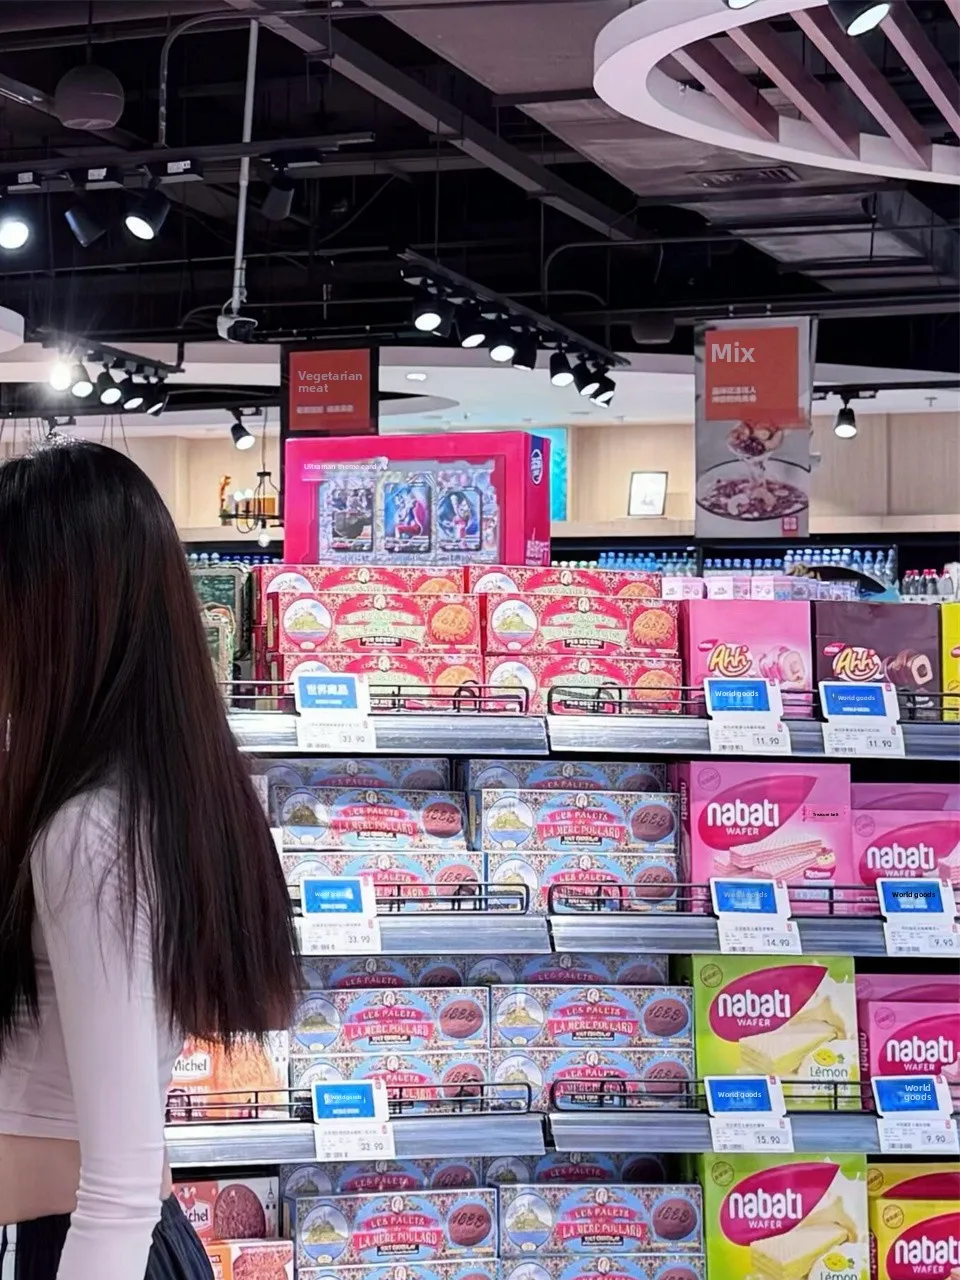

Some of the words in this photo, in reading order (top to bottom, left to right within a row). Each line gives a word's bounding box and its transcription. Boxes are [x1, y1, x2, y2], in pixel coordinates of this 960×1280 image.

[711, 342, 756, 363] Mix
[298, 370, 363, 383] Vegetarian
[298, 384, 329, 393] meat
[736, 690, 759, 699] goods
[868, 739, 892, 749] 11.90
[707, 799, 780, 827] nabati
[726, 827, 759, 836] WAFER
[913, 891, 936, 900] goods
[718, 989, 791, 1018] nabati
[737, 1018, 771, 1027] WAFER
[887, 1035, 953, 1063] nabati
[810, 1066, 848, 1078] Lémon
[905, 1084, 931, 1092] World
[740, 1091, 762, 1100] goods
[904, 1092, 932, 1102] goods
[756, 1135, 781, 1145] 15.90
[926, 1134, 946, 1144] 9.90
[748, 1219, 783, 1229] WAFER
[912, 1265, 945, 1275] WAFER
